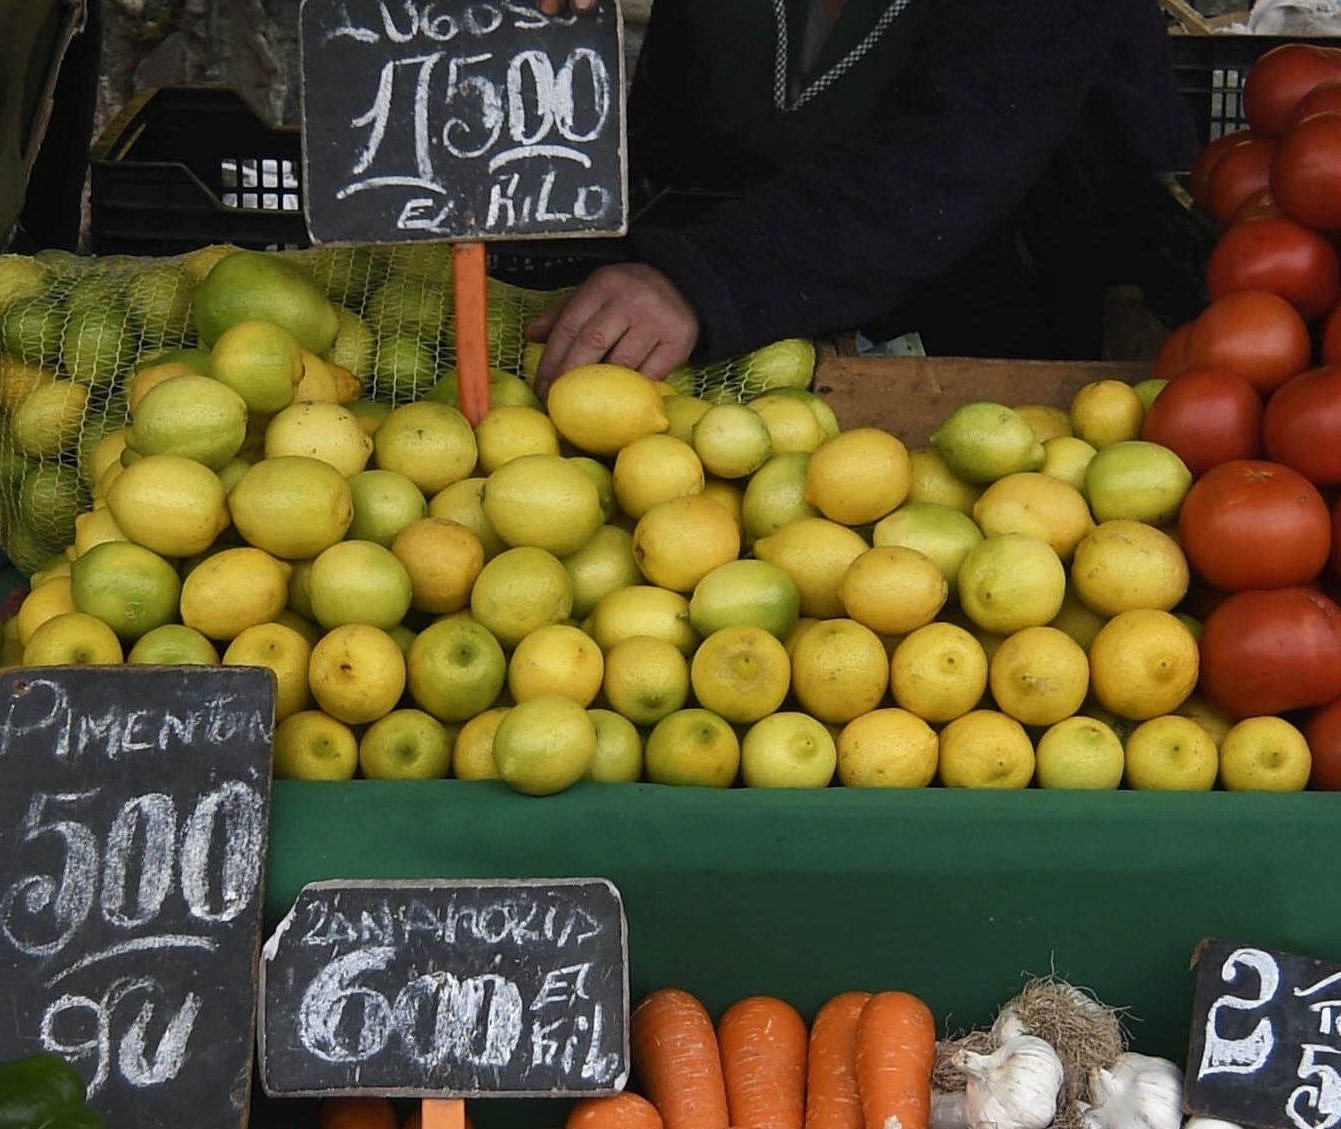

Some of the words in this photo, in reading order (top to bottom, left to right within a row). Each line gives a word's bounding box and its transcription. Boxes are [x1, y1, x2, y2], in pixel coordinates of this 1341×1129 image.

[0, 782, 263, 955] 500
[298, 946, 523, 1067] 600
[1197, 948, 1279, 1081] 2
